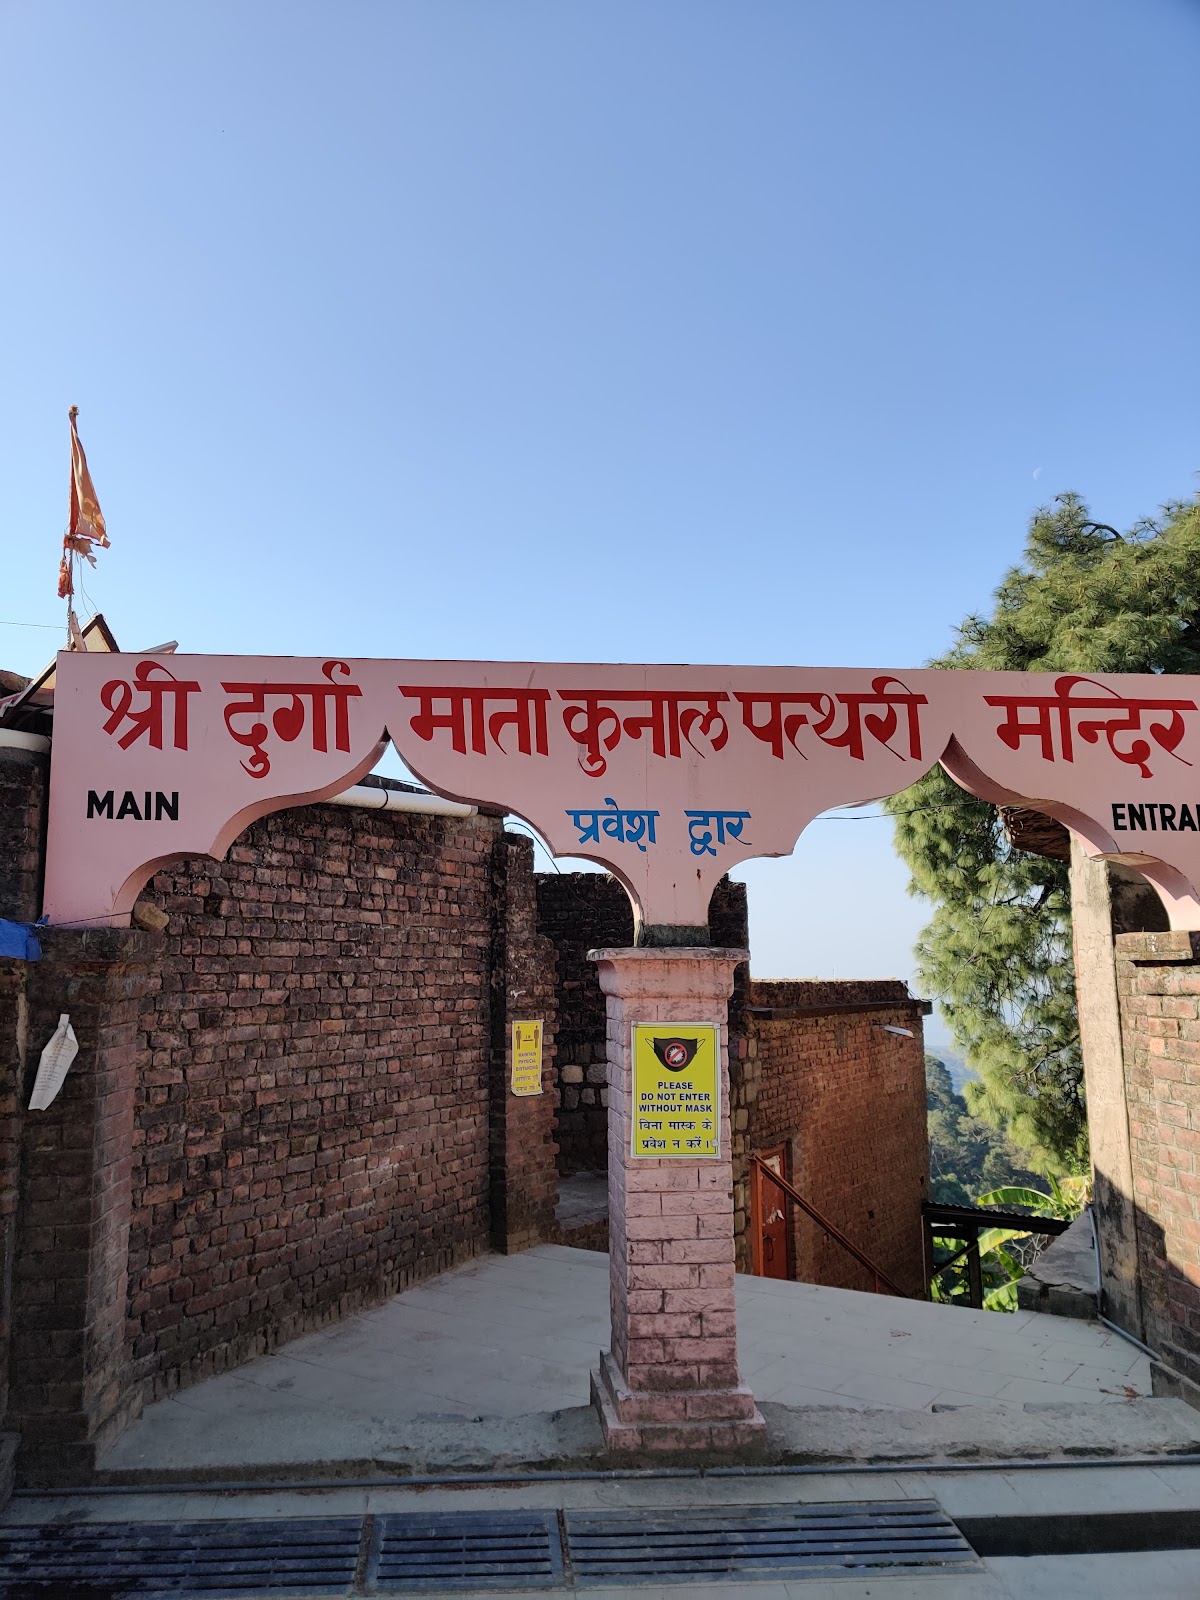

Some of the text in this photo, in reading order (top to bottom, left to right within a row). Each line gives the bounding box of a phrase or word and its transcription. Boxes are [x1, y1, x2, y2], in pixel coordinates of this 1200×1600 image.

[100, 660, 1199, 779] श्री दुर्गा माता कुनाल पत्थरी मन्दिर
[87, 790, 179, 821] MAIN
[1112, 803, 1200, 832] ENTRA
[565, 797, 752, 857] प्रवेश द्वार
[641, 1093, 710, 1101] DO NOT ENTER
[668, 1121, 696, 1130] मास्क
[701, 1118, 712, 1130] के
[642, 1136, 666, 1149] प्रवेश
[672, 1140, 680, 1149] न
